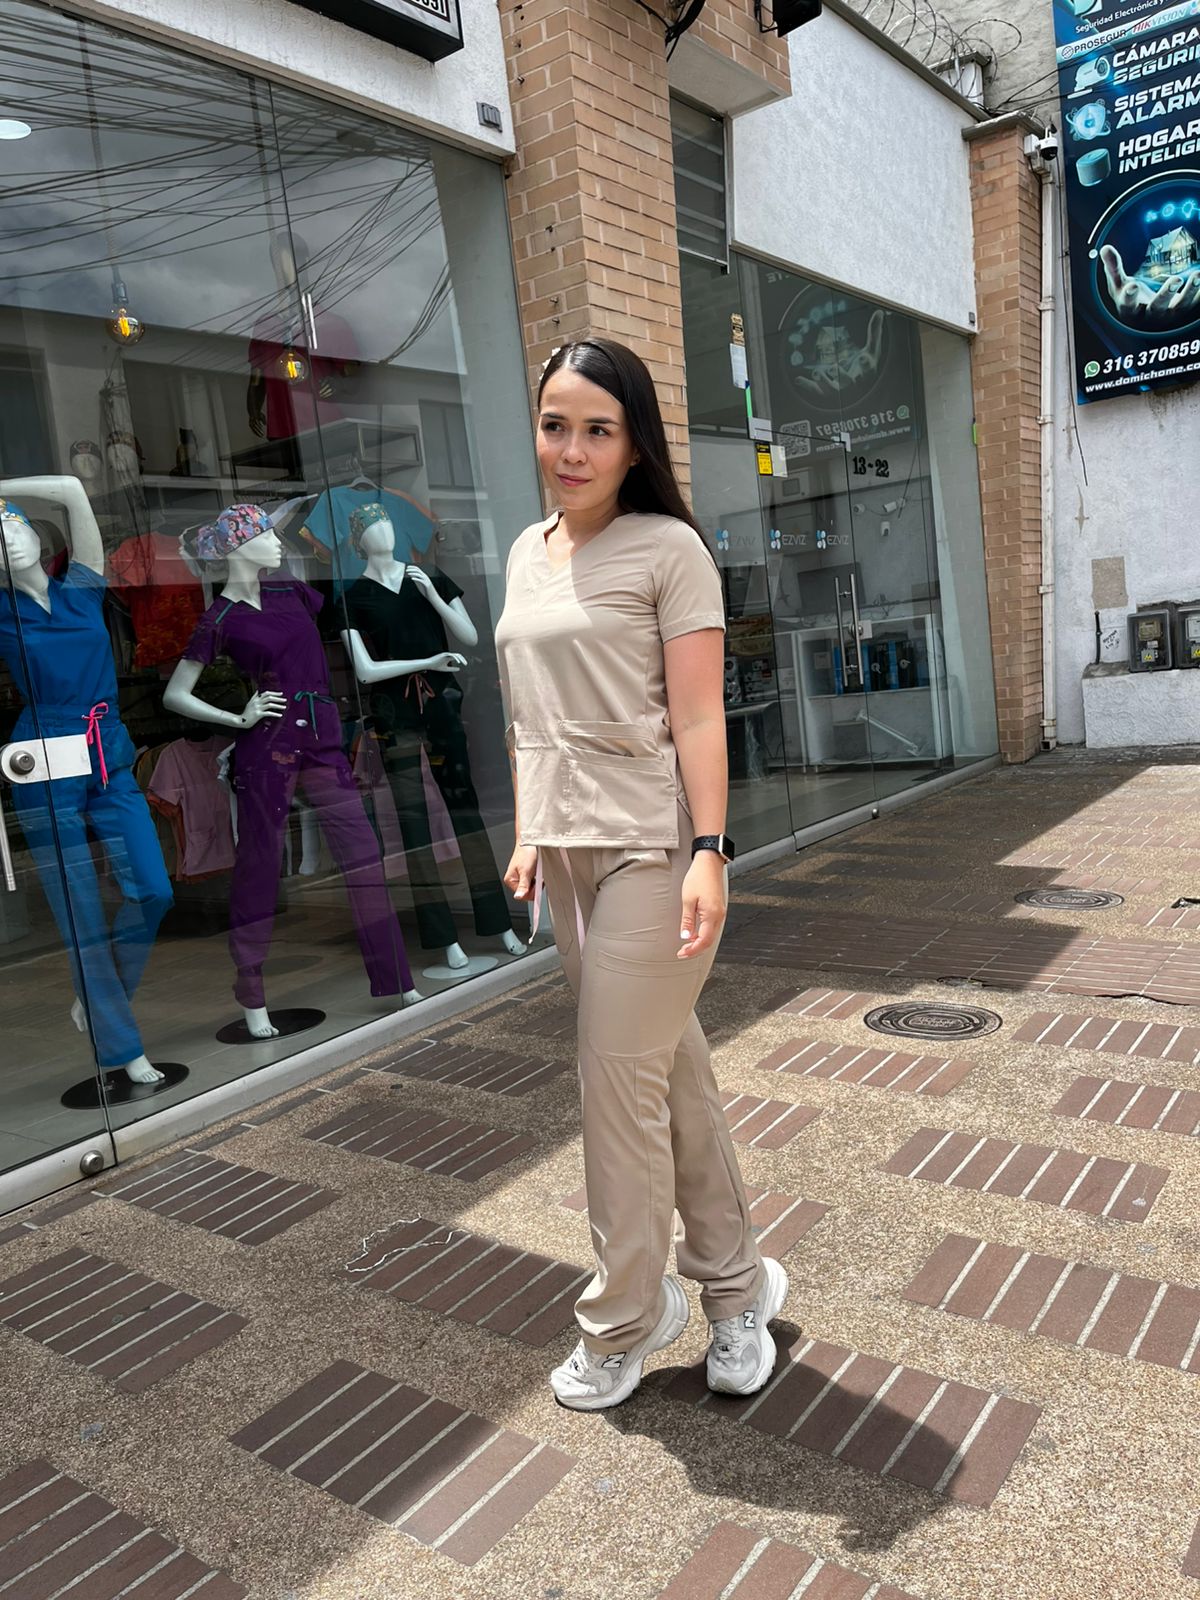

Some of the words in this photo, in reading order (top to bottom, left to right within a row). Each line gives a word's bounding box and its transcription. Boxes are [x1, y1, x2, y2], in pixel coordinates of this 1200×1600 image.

[1075, 14, 1113, 33] Seguridad
[1115, 0, 1158, 19] Electrónica
[1075, 29, 1127, 53] PROSEGUR
[1116, 90, 1200, 130] ALARM
[1118, 119, 1200, 158] HOGAR
[1102, 354, 1134, 374] 316
[1137, 339, 1200, 367] 370859
[781, 534, 807, 546] EZVIZ
[826, 534, 849, 546] EZVIZ
[742, 1310, 756, 1329] N
[601, 1351, 627, 1369] N
